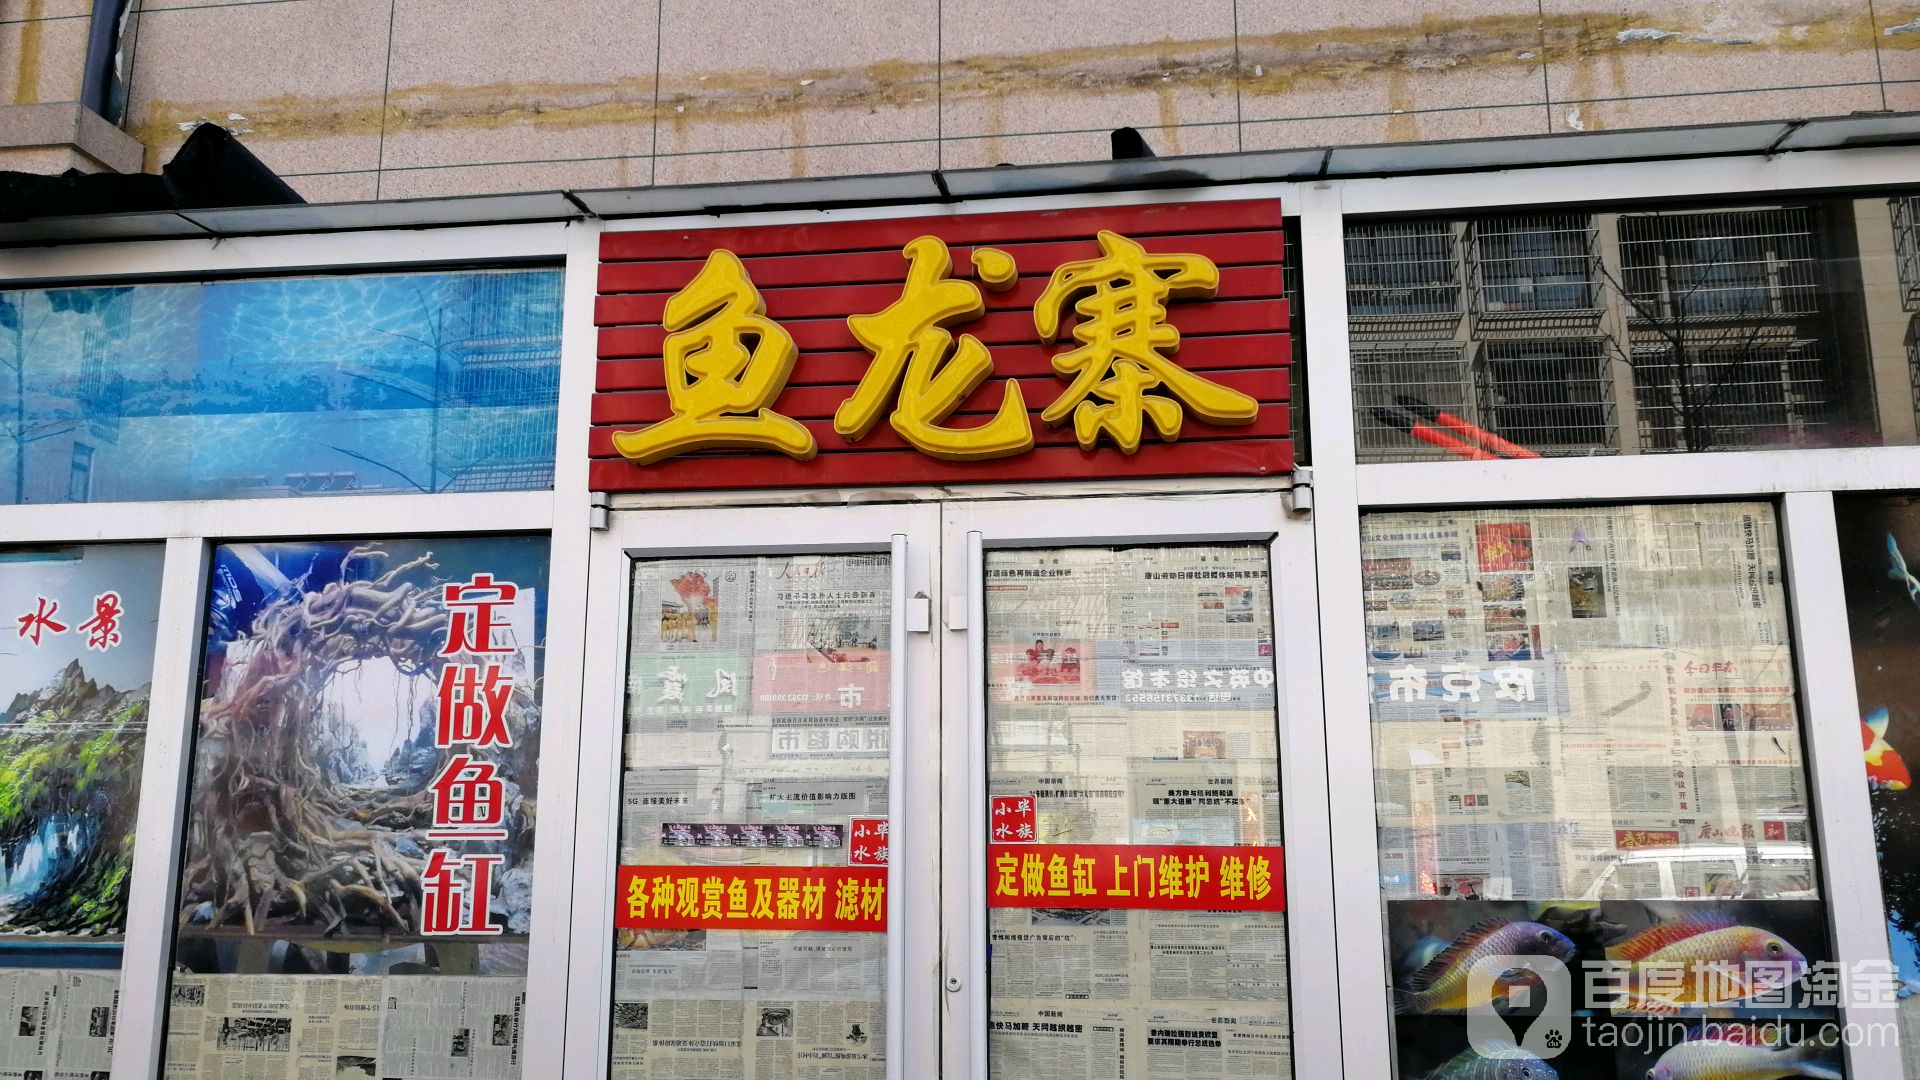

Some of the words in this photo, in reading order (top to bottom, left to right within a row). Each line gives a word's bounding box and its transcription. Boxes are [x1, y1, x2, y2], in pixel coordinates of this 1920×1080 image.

[611, 229, 1260, 466] 鱼龙寨
[17, 591, 125, 651] 水景
[421, 573, 521, 936] 定做鱼缸
[626, 875, 827, 921] 各种观赏鱼及器材
[834, 878, 887, 921] 滤材
[995, 851, 1098, 898] 定做鱼缸
[1106, 853, 1211, 900] 上门维护
[1219, 854, 1272, 901] 维修
